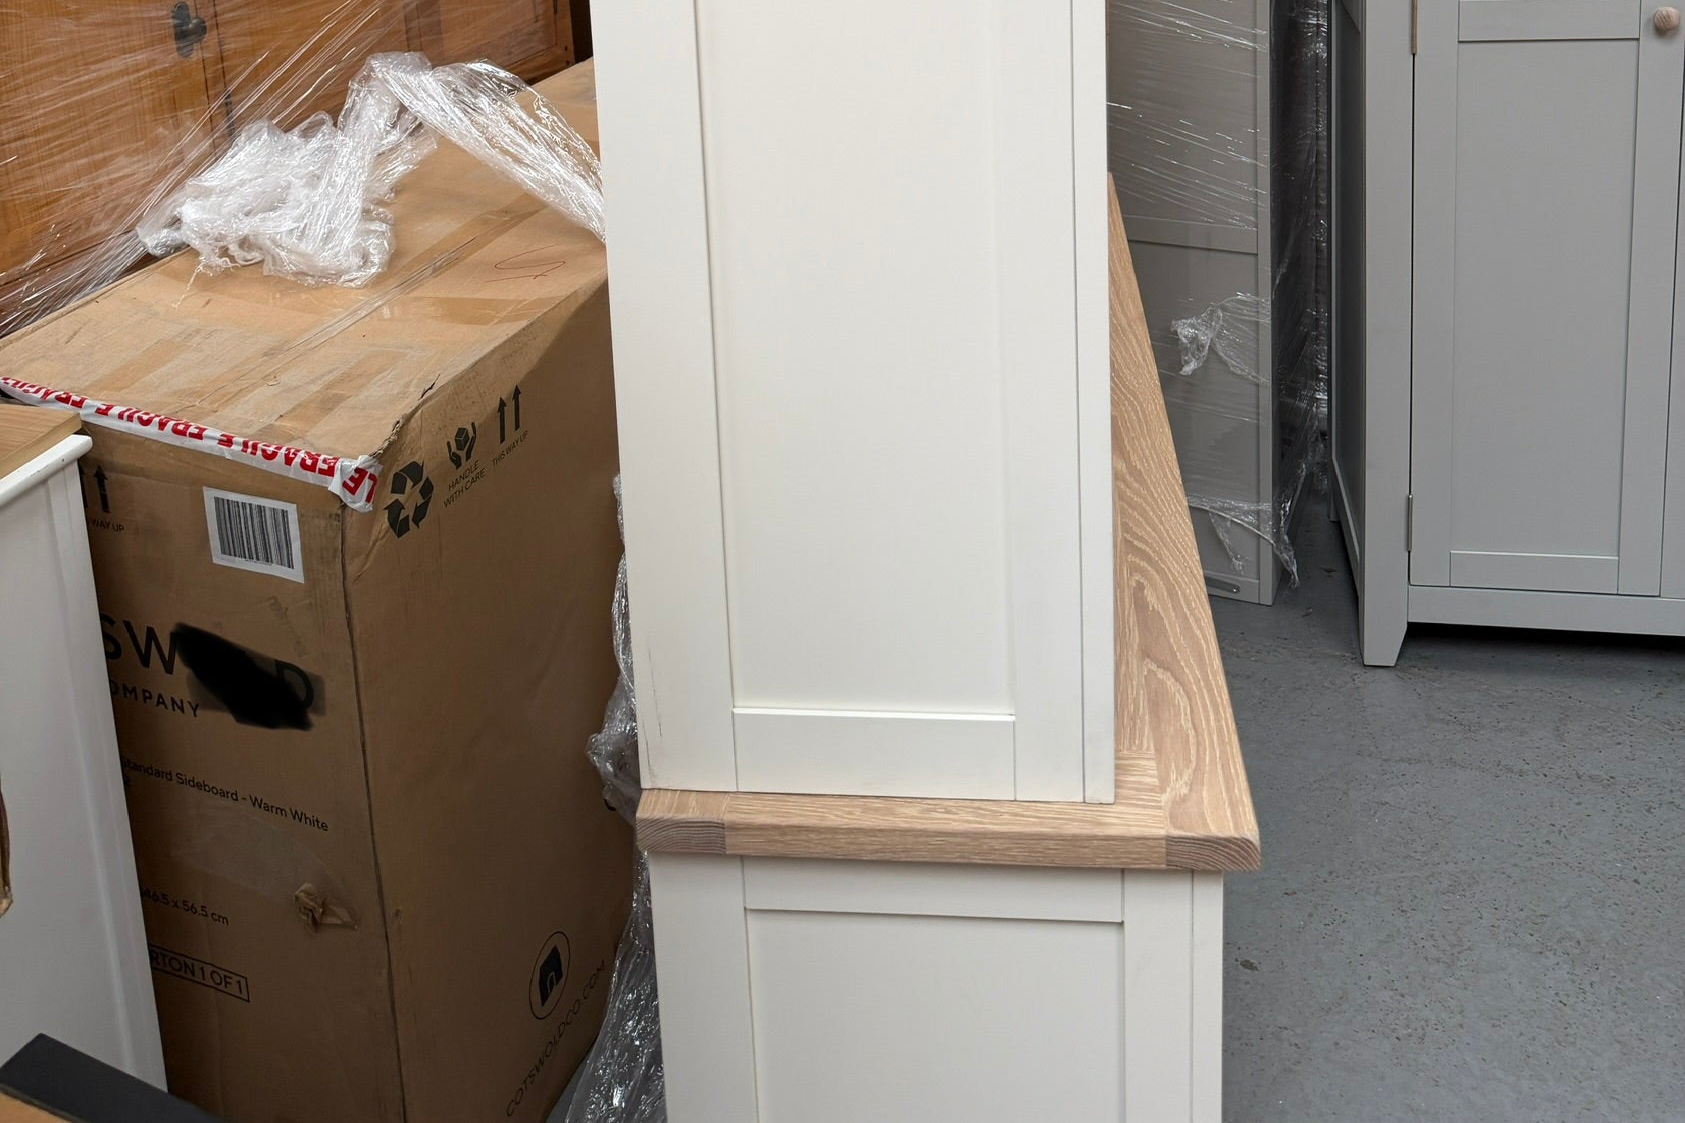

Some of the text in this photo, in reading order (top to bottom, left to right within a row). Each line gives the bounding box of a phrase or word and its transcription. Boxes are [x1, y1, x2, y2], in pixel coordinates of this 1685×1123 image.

[443, 467, 486, 508] WITH CARE
[448, 459, 479, 491] HANDLE
[174, 772, 239, 802] Sideboard
[249, 795, 288, 818] Warm
[290, 807, 329, 832] White
[172, 899, 179, 909] x
[182, 900, 208, 918] 56.5
[211, 912, 229, 926] cm
[200, 966, 206, 981] 1
[210, 969, 233, 988] OF
[236, 980, 242, 994] 1
